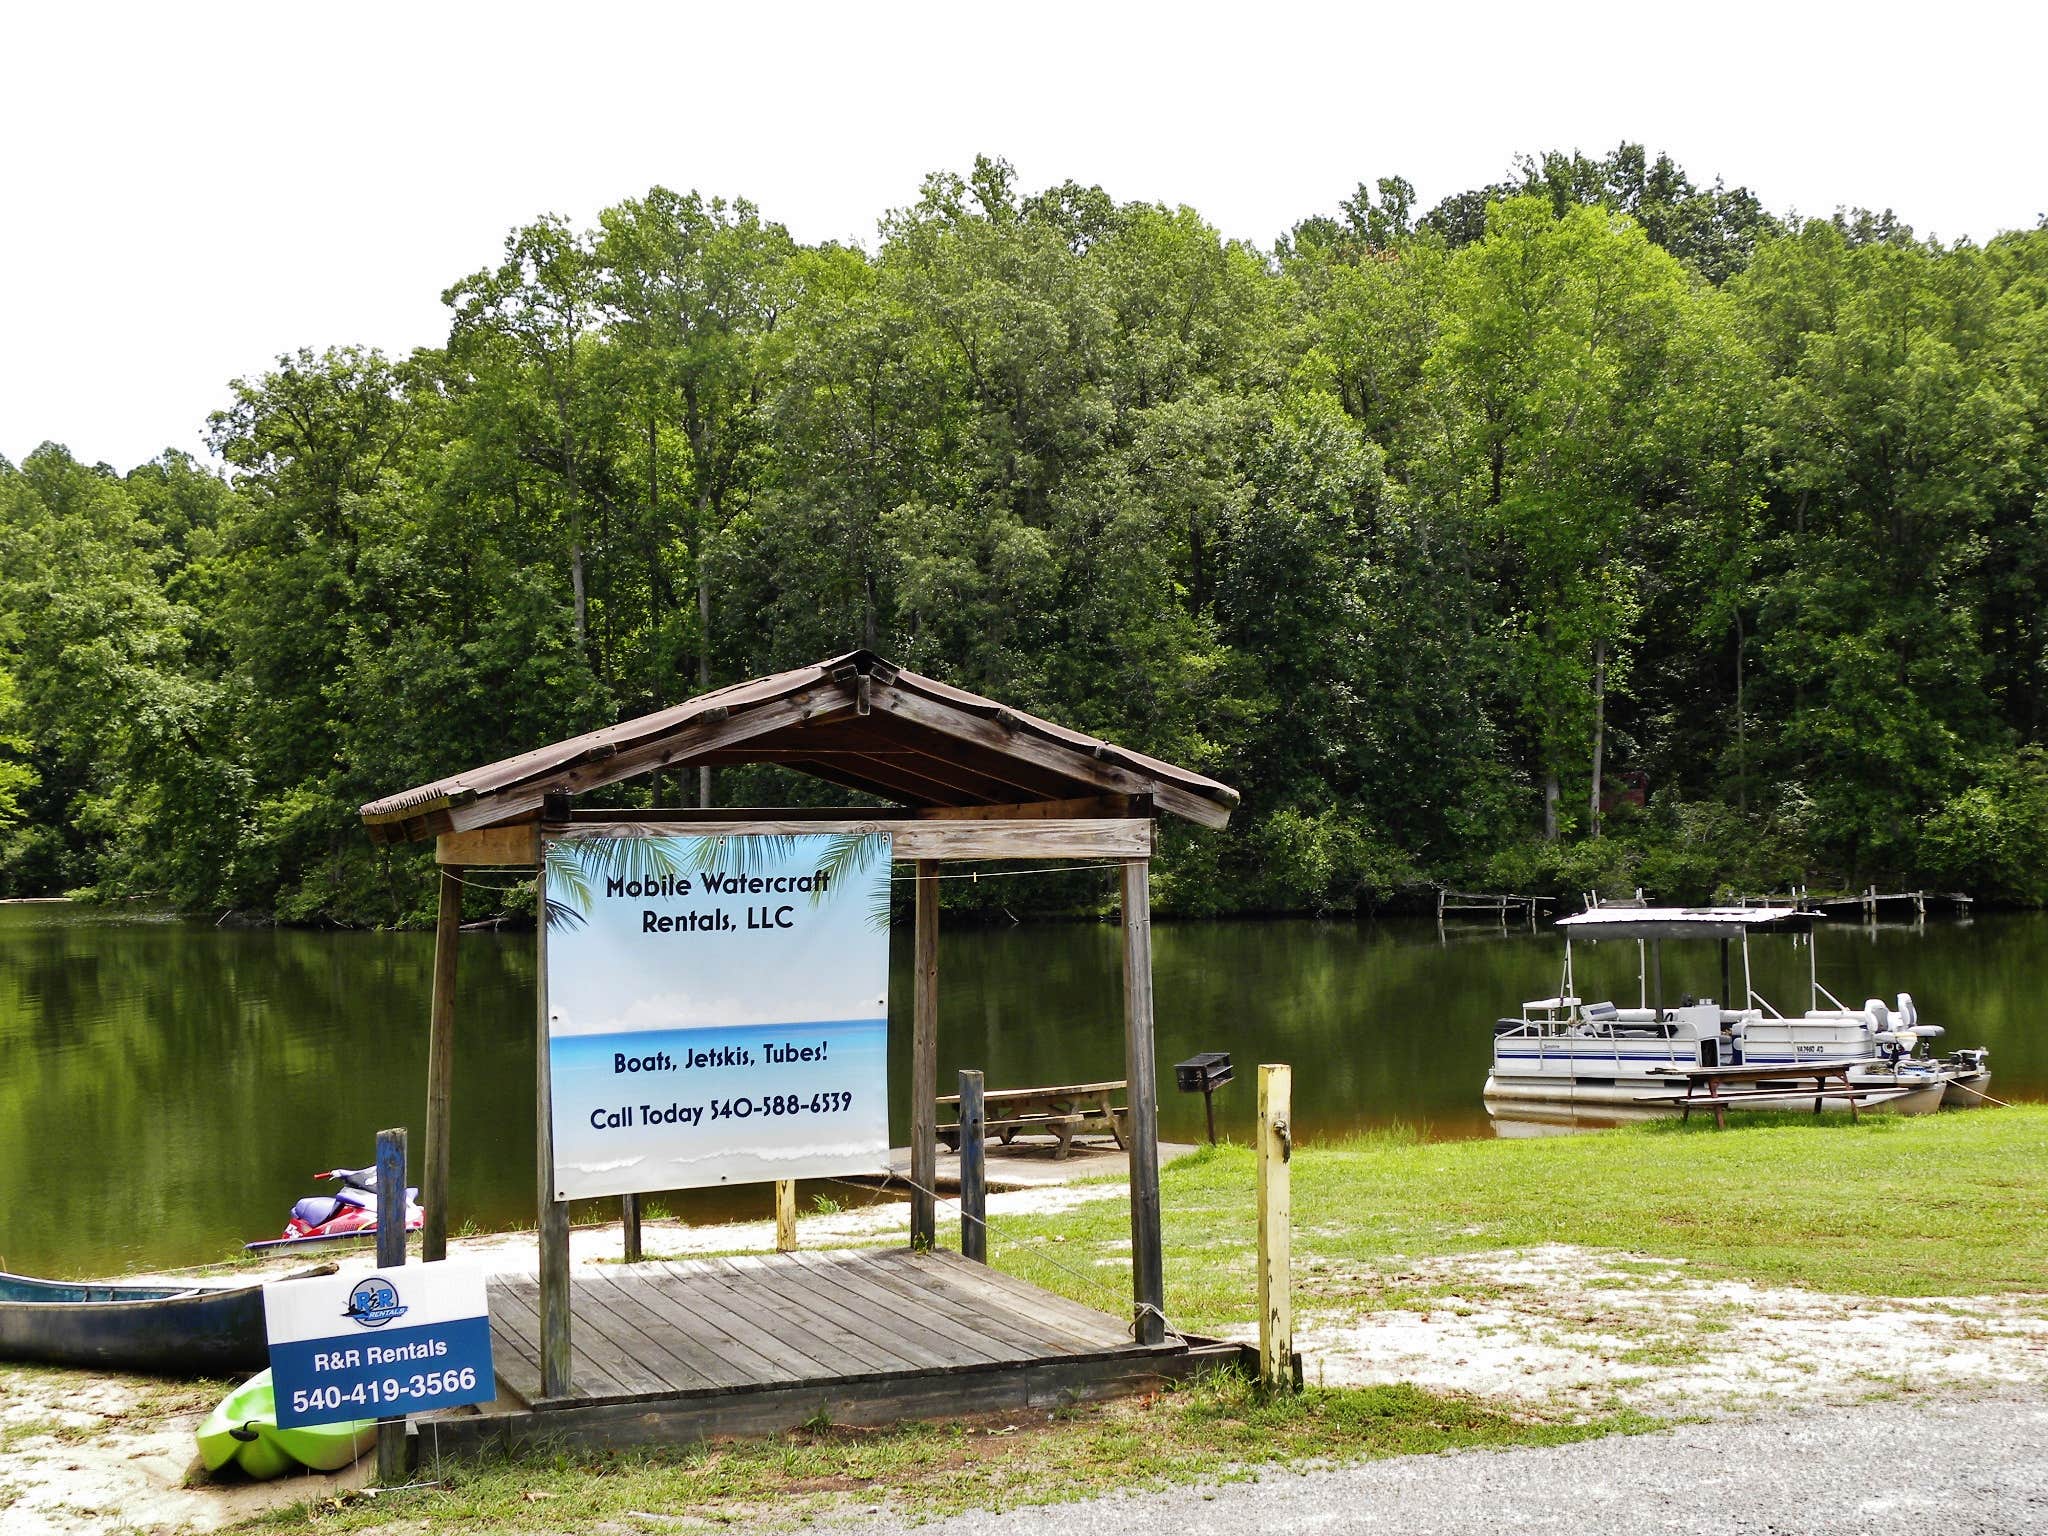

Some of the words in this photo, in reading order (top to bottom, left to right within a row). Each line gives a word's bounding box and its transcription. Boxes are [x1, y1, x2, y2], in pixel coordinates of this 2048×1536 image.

[606, 873, 692, 898] Mobile
[700, 869, 830, 895] Watercraft
[642, 908, 737, 933] Rentals,
[747, 905, 794, 929] LLC
[614, 1051, 677, 1074] Boats,
[685, 1046, 756, 1069] Jetskis,
[763, 1040, 828, 1064] Tubes!
[590, 1106, 633, 1130] Call
[640, 1103, 704, 1127] Today
[711, 1091, 853, 1120] 540-588-6539
[368, 1307, 406, 1319] RENTALS
[314, 1349, 361, 1372] R&R
[367, 1339, 448, 1365] Rentals
[293, 1367, 477, 1413] 540-419-3566
